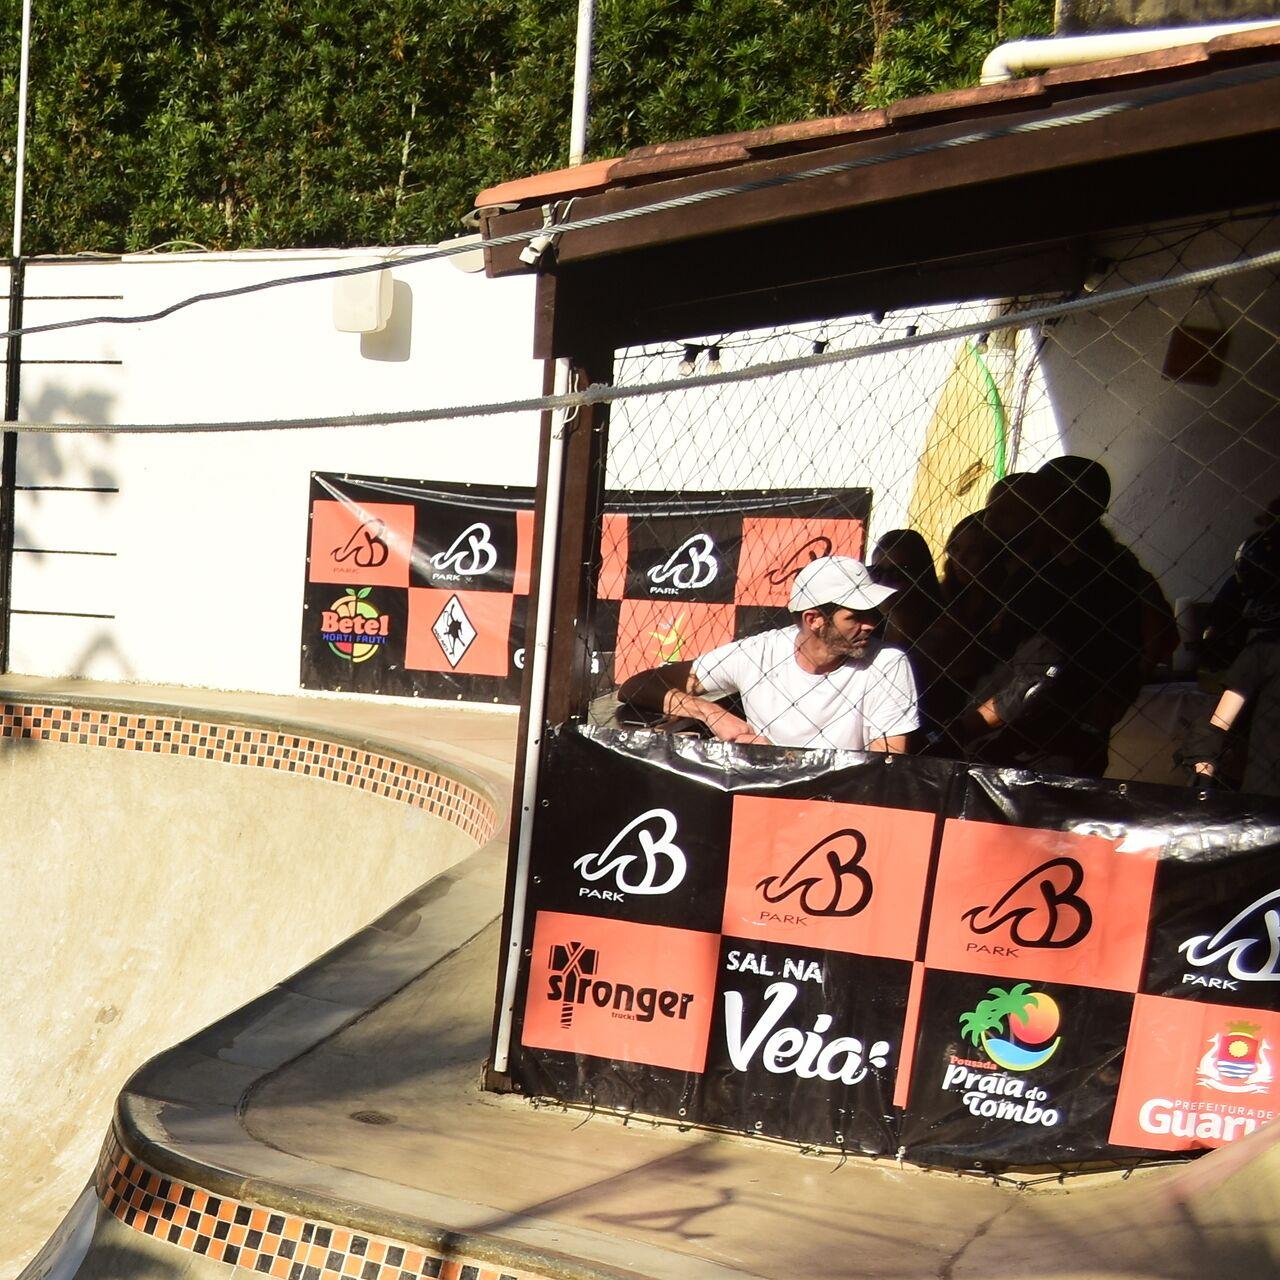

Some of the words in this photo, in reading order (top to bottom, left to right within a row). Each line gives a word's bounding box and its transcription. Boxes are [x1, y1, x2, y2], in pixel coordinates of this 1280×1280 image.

[432, 573, 461, 581] PARK
[650, 586, 680, 595] PARK
[320, 610, 390, 637] Betel
[579, 887, 625, 903] PARK
[759, 910, 809, 926] PARK
[966, 941, 1020, 958] PARK
[725, 950, 775, 977] SAL
[784, 960, 824, 984] NA
[1181, 973, 1240, 991] PARK
[949, 1055, 998, 1071] Pousada
[1025, 1086, 1048, 1101] do
[962, 1091, 1059, 1126] Tombo
[1174, 1099, 1255, 1117] PREFEITURA
[1257, 1109, 1274, 1120] DE
